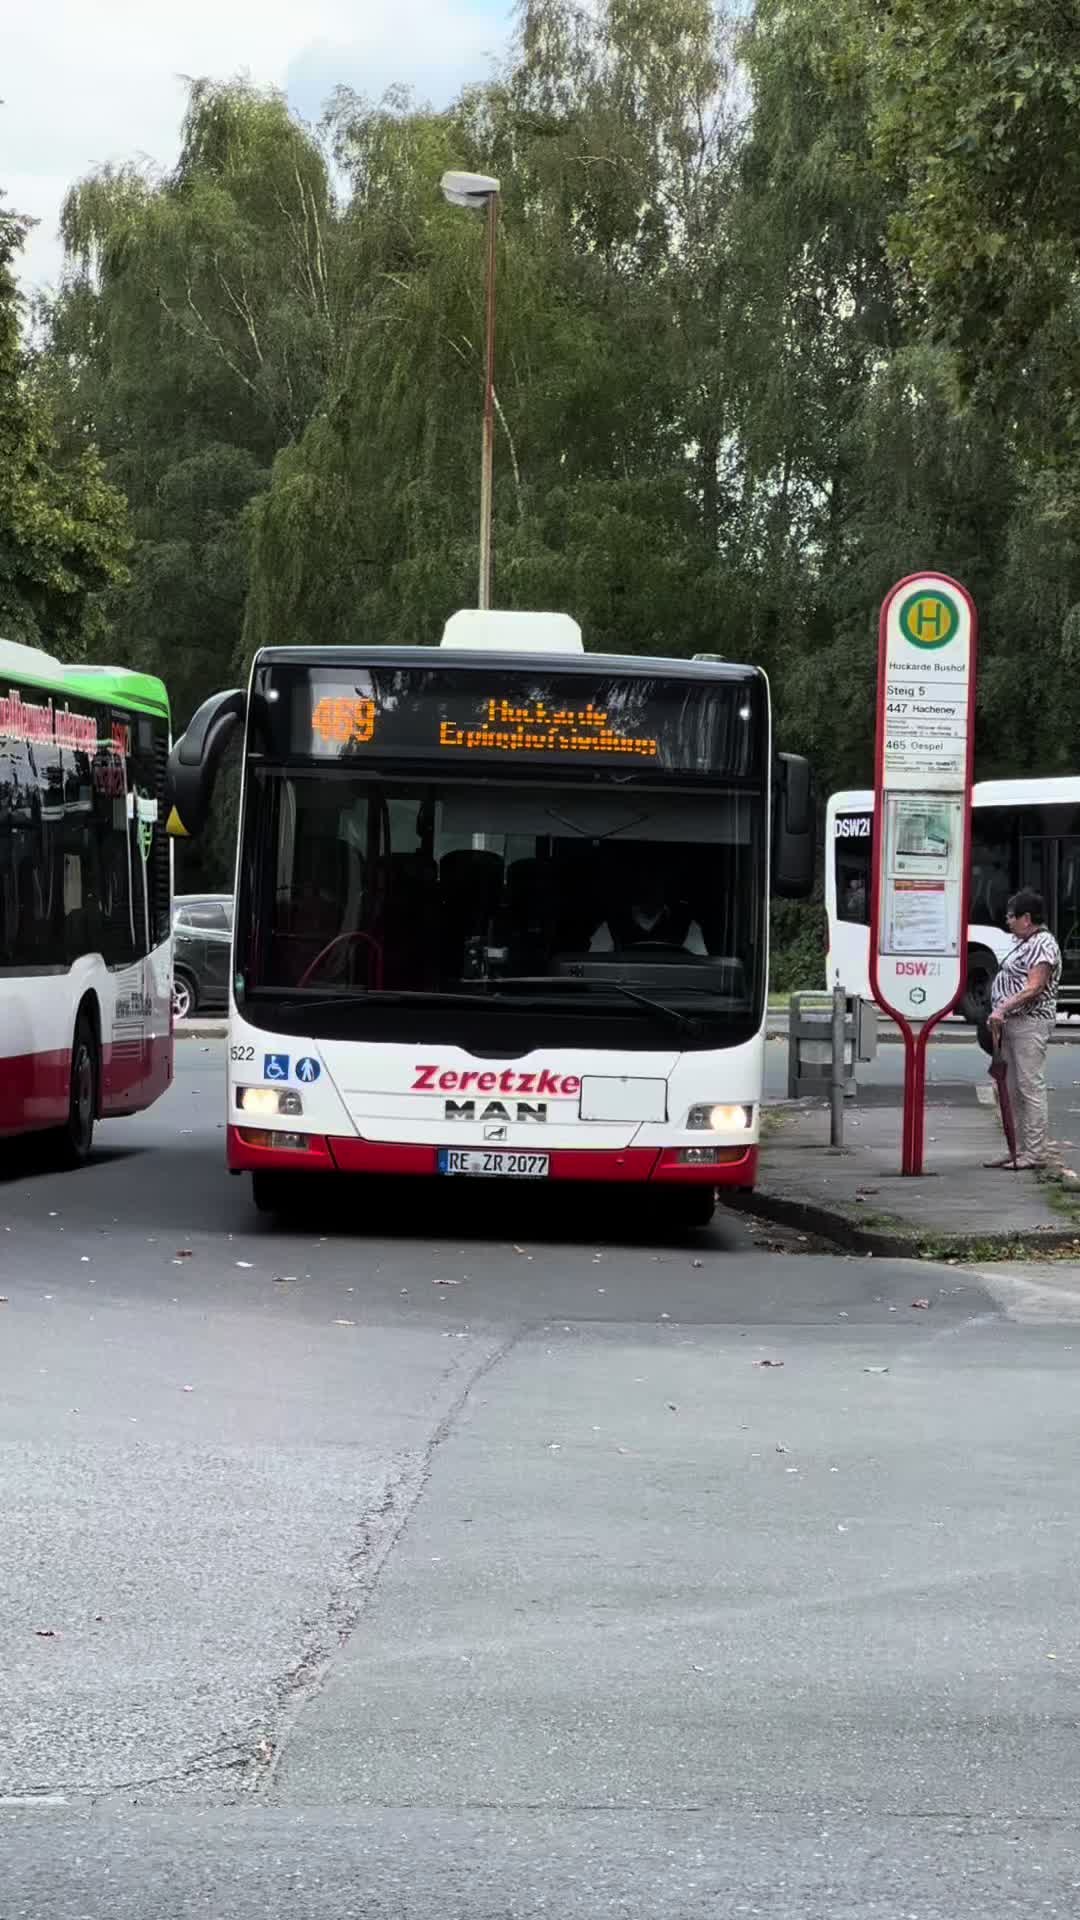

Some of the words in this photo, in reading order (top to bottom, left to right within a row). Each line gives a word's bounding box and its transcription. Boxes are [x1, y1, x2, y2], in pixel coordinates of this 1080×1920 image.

[917, 602, 941, 636] H
[889, 661, 932, 671] Huckarde
[934, 662, 966, 673] Bushof
[887, 685, 915, 697] Steig
[918, 686, 926, 696] 5
[887, 703, 908, 713] 447
[912, 705, 956, 715] Hacheney
[886, 740, 906, 750] 465
[911, 741, 944, 751] Oespel
[895, 962, 941, 976] DSW21
[410, 1065, 580, 1095] Zeretzke
[444, 1100, 548, 1122] MAN
[449, 1152, 470, 1170] RE
[482, 1154, 504, 1171] ZR
[507, 1155, 548, 1173] 2077
